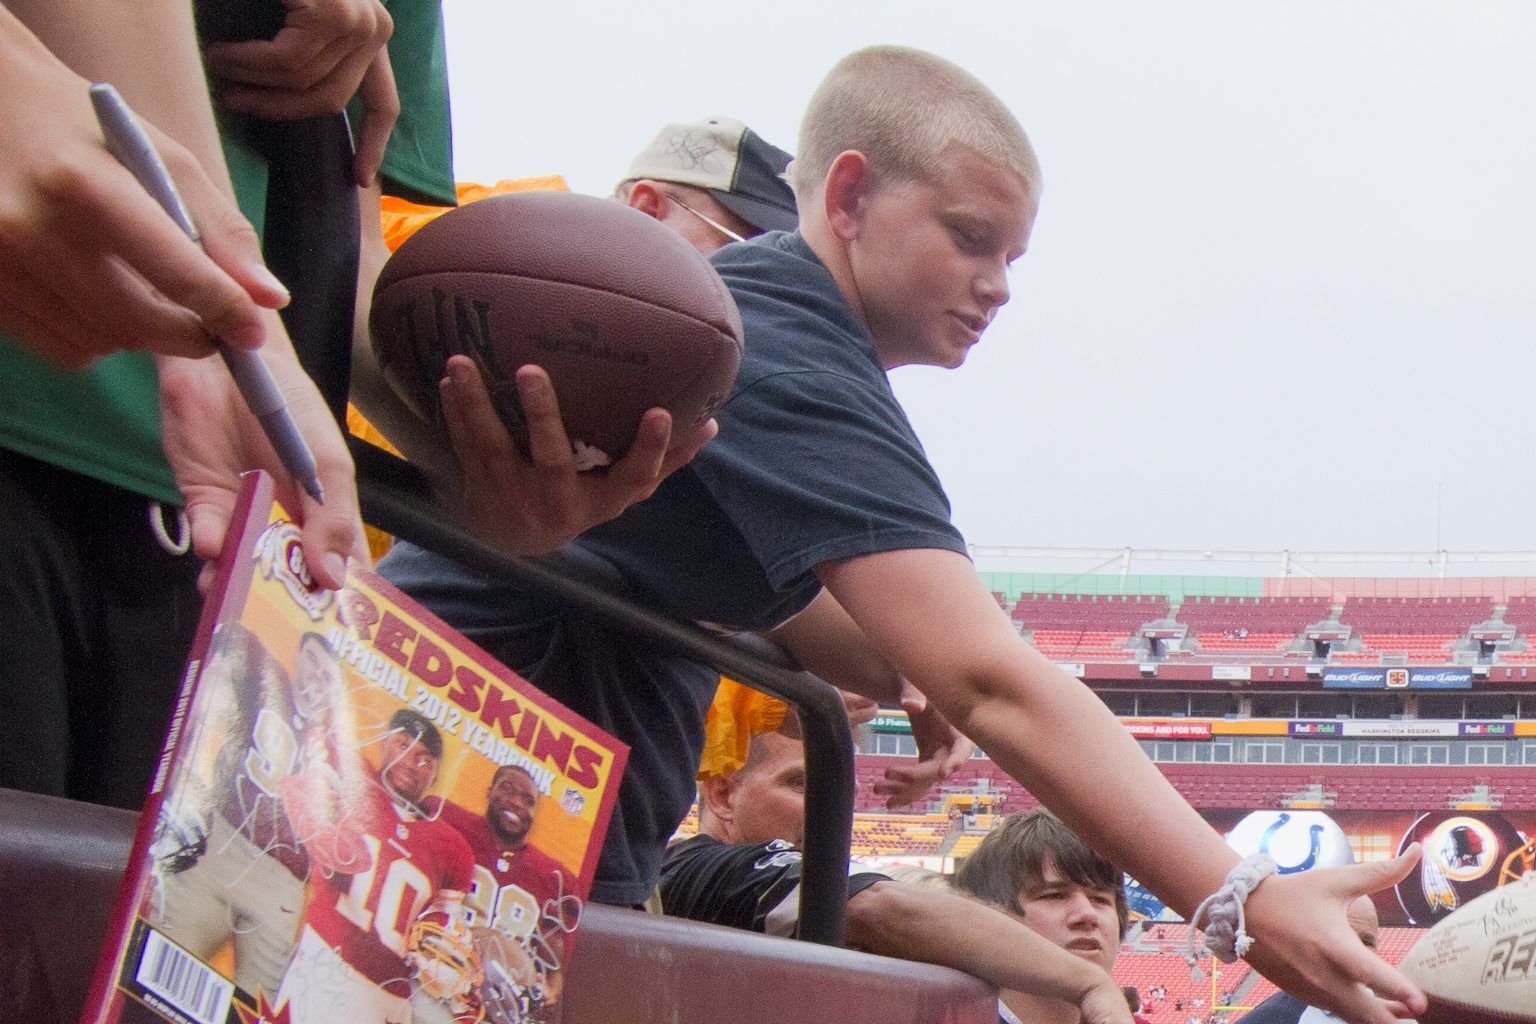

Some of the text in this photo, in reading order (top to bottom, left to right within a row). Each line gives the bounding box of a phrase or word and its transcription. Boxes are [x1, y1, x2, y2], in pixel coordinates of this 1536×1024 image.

[1324, 672, 1384, 682] BUD LIGHT
[1389, 672, 1406, 685] 25
[1411, 672, 1471, 682] BUD LIGHT
[336, 587, 604, 790] REDSKINS
[327, 625, 557, 798] OFFICIAL 2012 YEARBOOK
[1154, 725, 1172, 735] AND
[1172, 725, 1190, 735] FOR
[1295, 723, 1335, 734] FedExField
[1361, 727, 1442, 735] WASHINGTON REDSKINS
[1465, 723, 1506, 734] FedExField
[335, 833, 433, 957] 10
